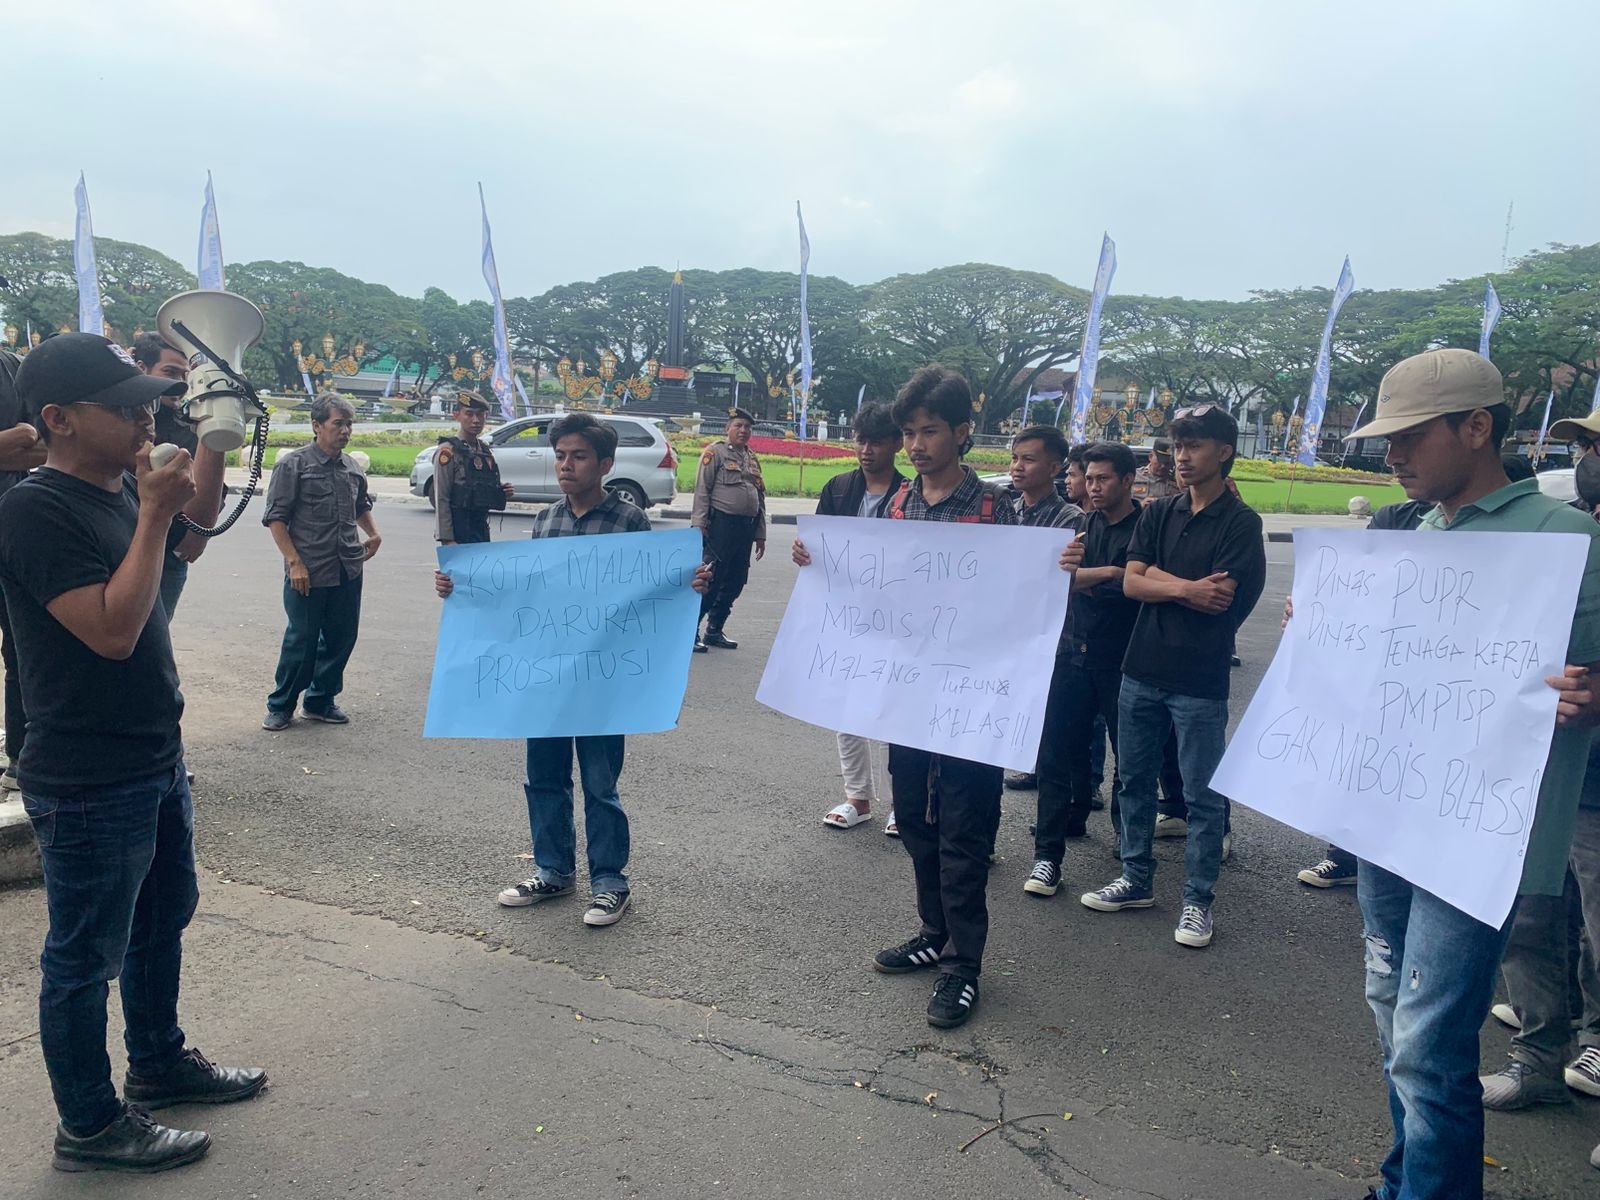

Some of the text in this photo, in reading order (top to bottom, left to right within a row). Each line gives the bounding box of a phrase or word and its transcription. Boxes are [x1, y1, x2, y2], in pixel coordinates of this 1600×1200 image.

[467, 544, 682, 597] KOTA MALANG
[1392, 559, 1480, 625] PUPR
[513, 598, 673, 640] DARURAT
[821, 602, 913, 639] MBOIS
[475, 649, 650, 698] PROSTITUSI
[1380, 625, 1465, 669] TENAGA
[1474, 637, 1540, 680] KERJA
[1257, 706, 1325, 772] GAK
[1379, 680, 1496, 746] PMPTSP
